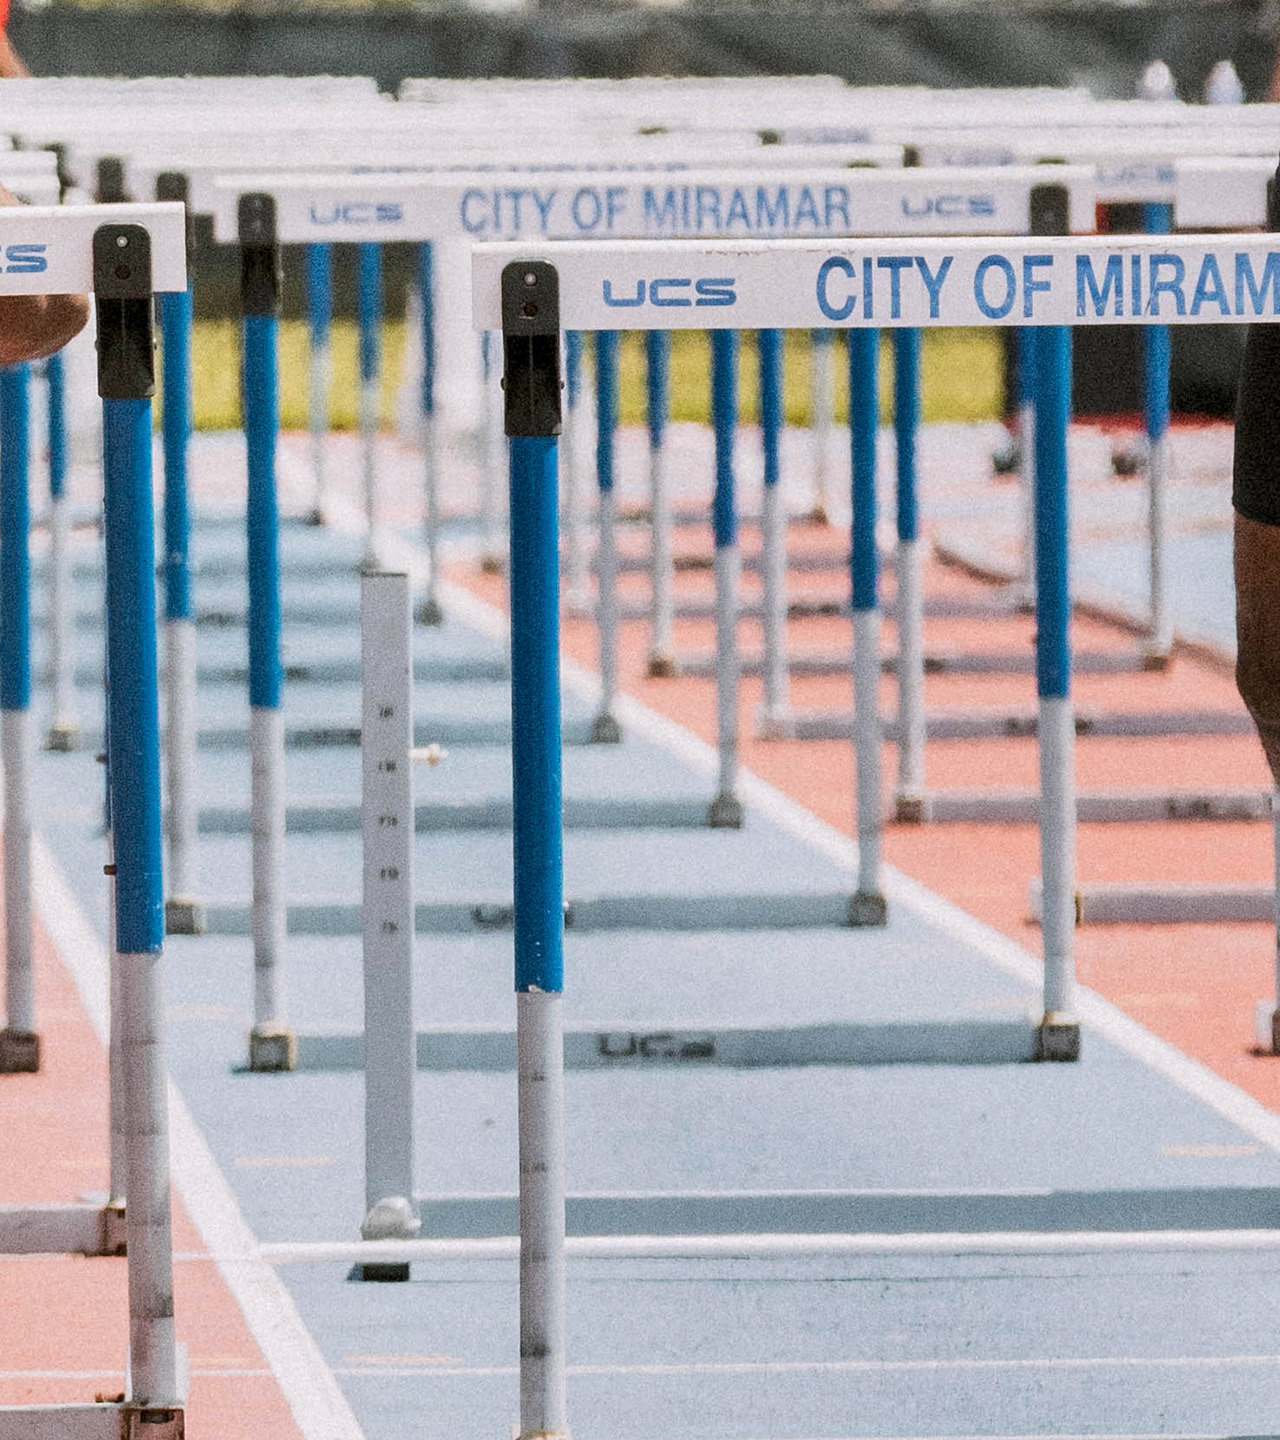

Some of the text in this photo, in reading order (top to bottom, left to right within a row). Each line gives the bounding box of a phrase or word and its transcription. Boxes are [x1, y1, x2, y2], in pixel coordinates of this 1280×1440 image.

[310, 184, 996, 234] UCS CITY OF MIRAMAR UCS
[602, 251, 1280, 320] UCS CITY OF MIRAM
